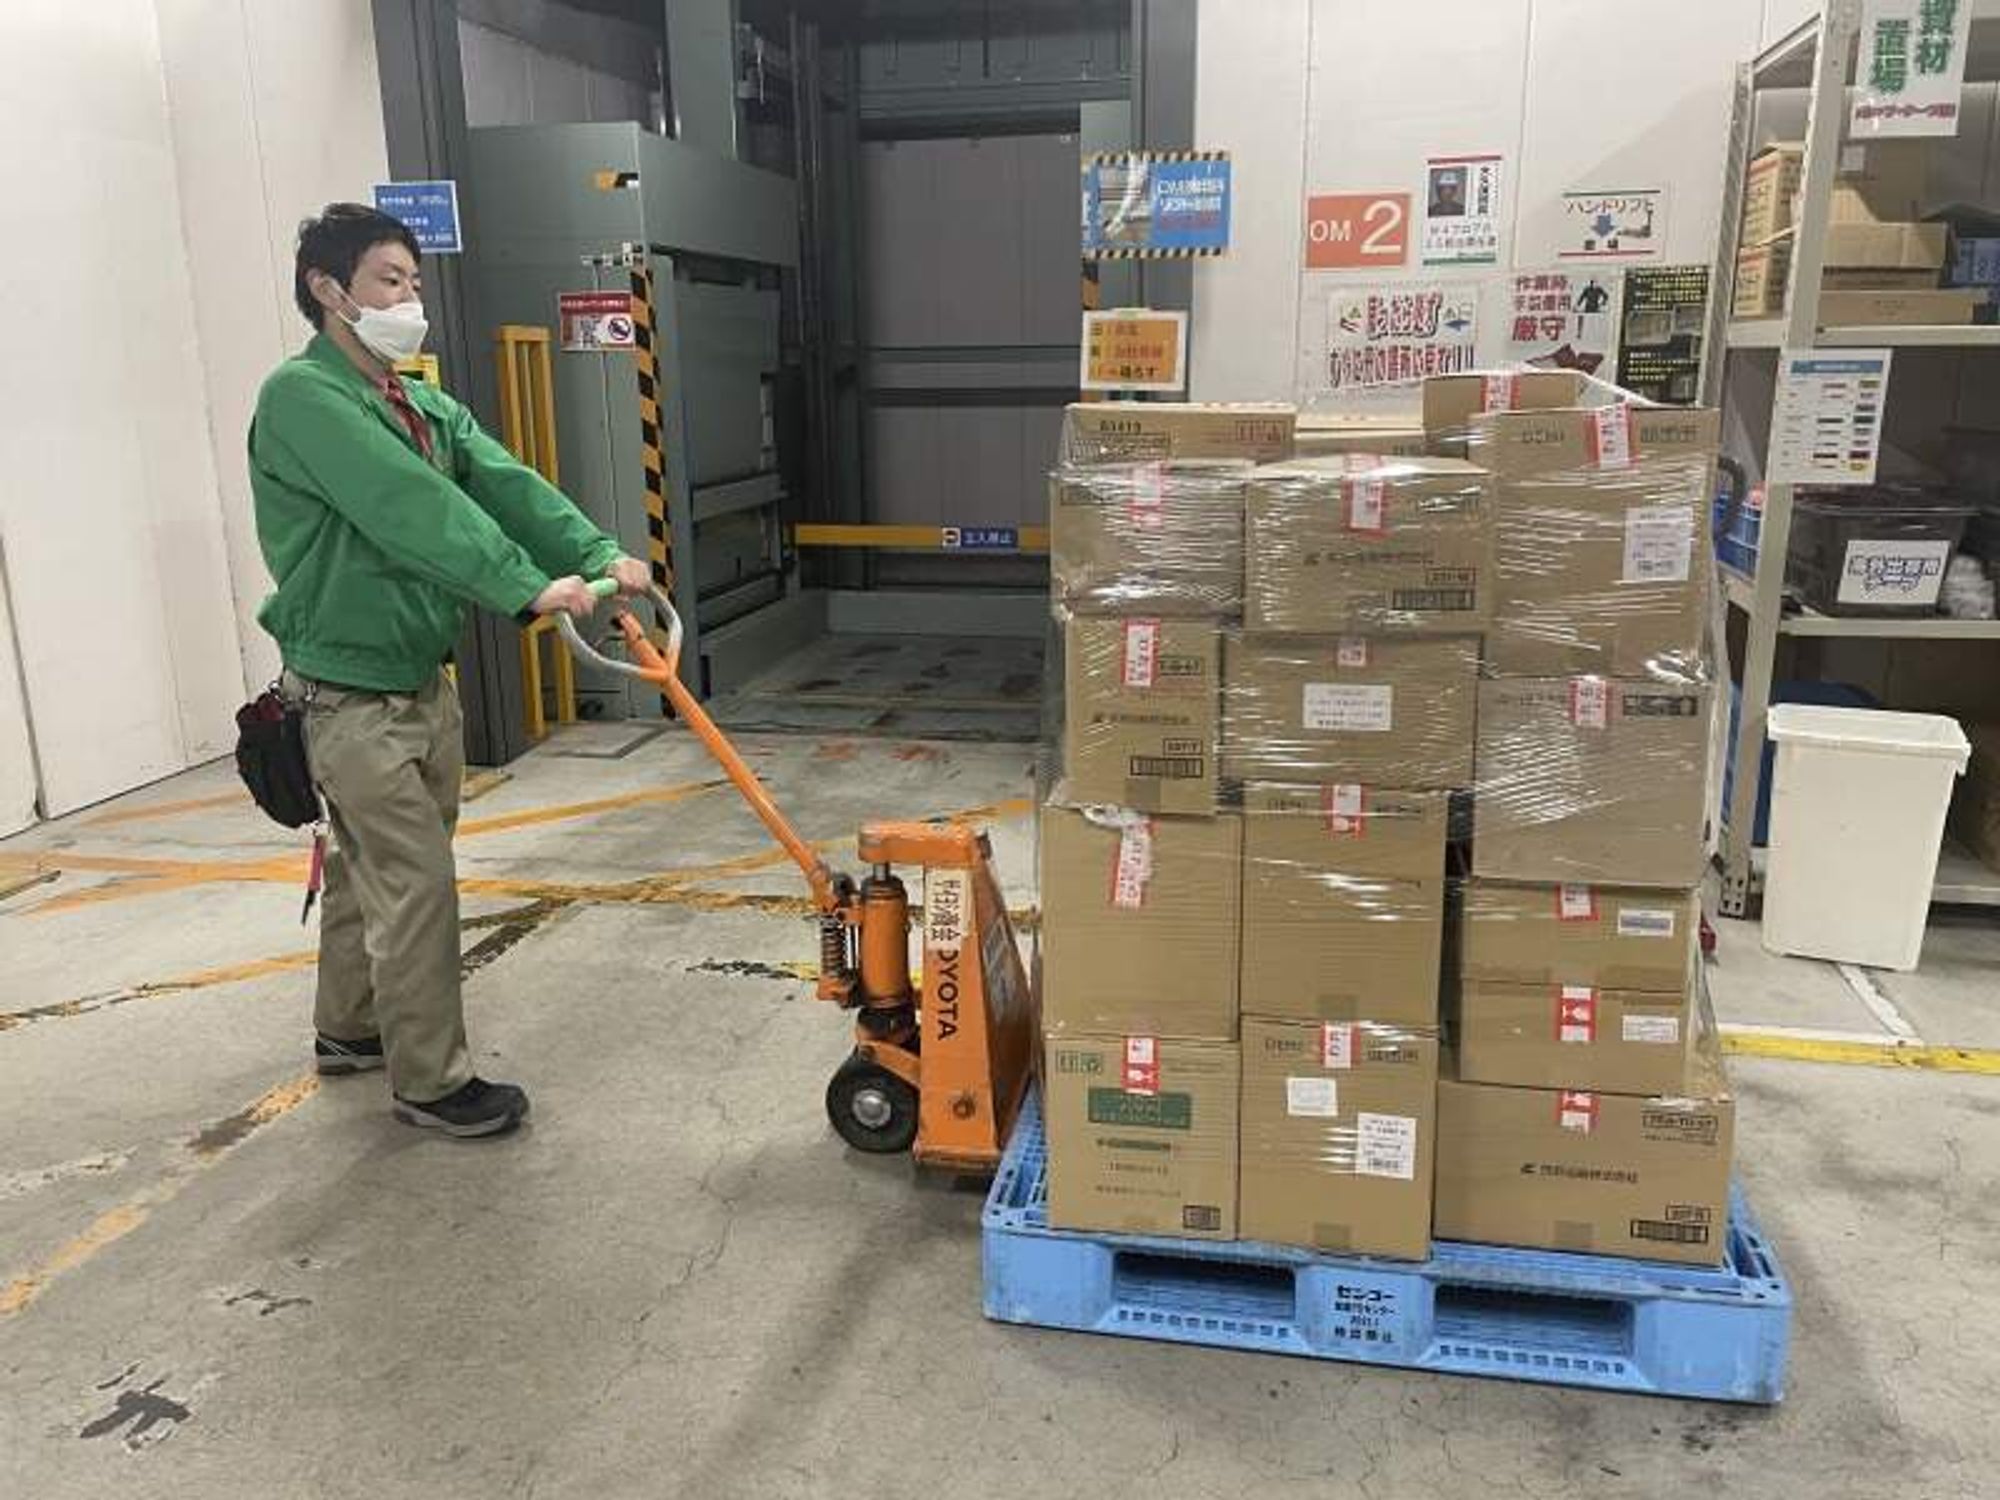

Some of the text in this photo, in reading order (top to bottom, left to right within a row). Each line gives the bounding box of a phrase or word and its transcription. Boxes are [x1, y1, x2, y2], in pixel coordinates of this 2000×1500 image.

[1310, 200, 1401, 254] OM 2
[1512, 315, 1566, 341] 厳守
[1337, 1285, 1395, 1301] センコー
